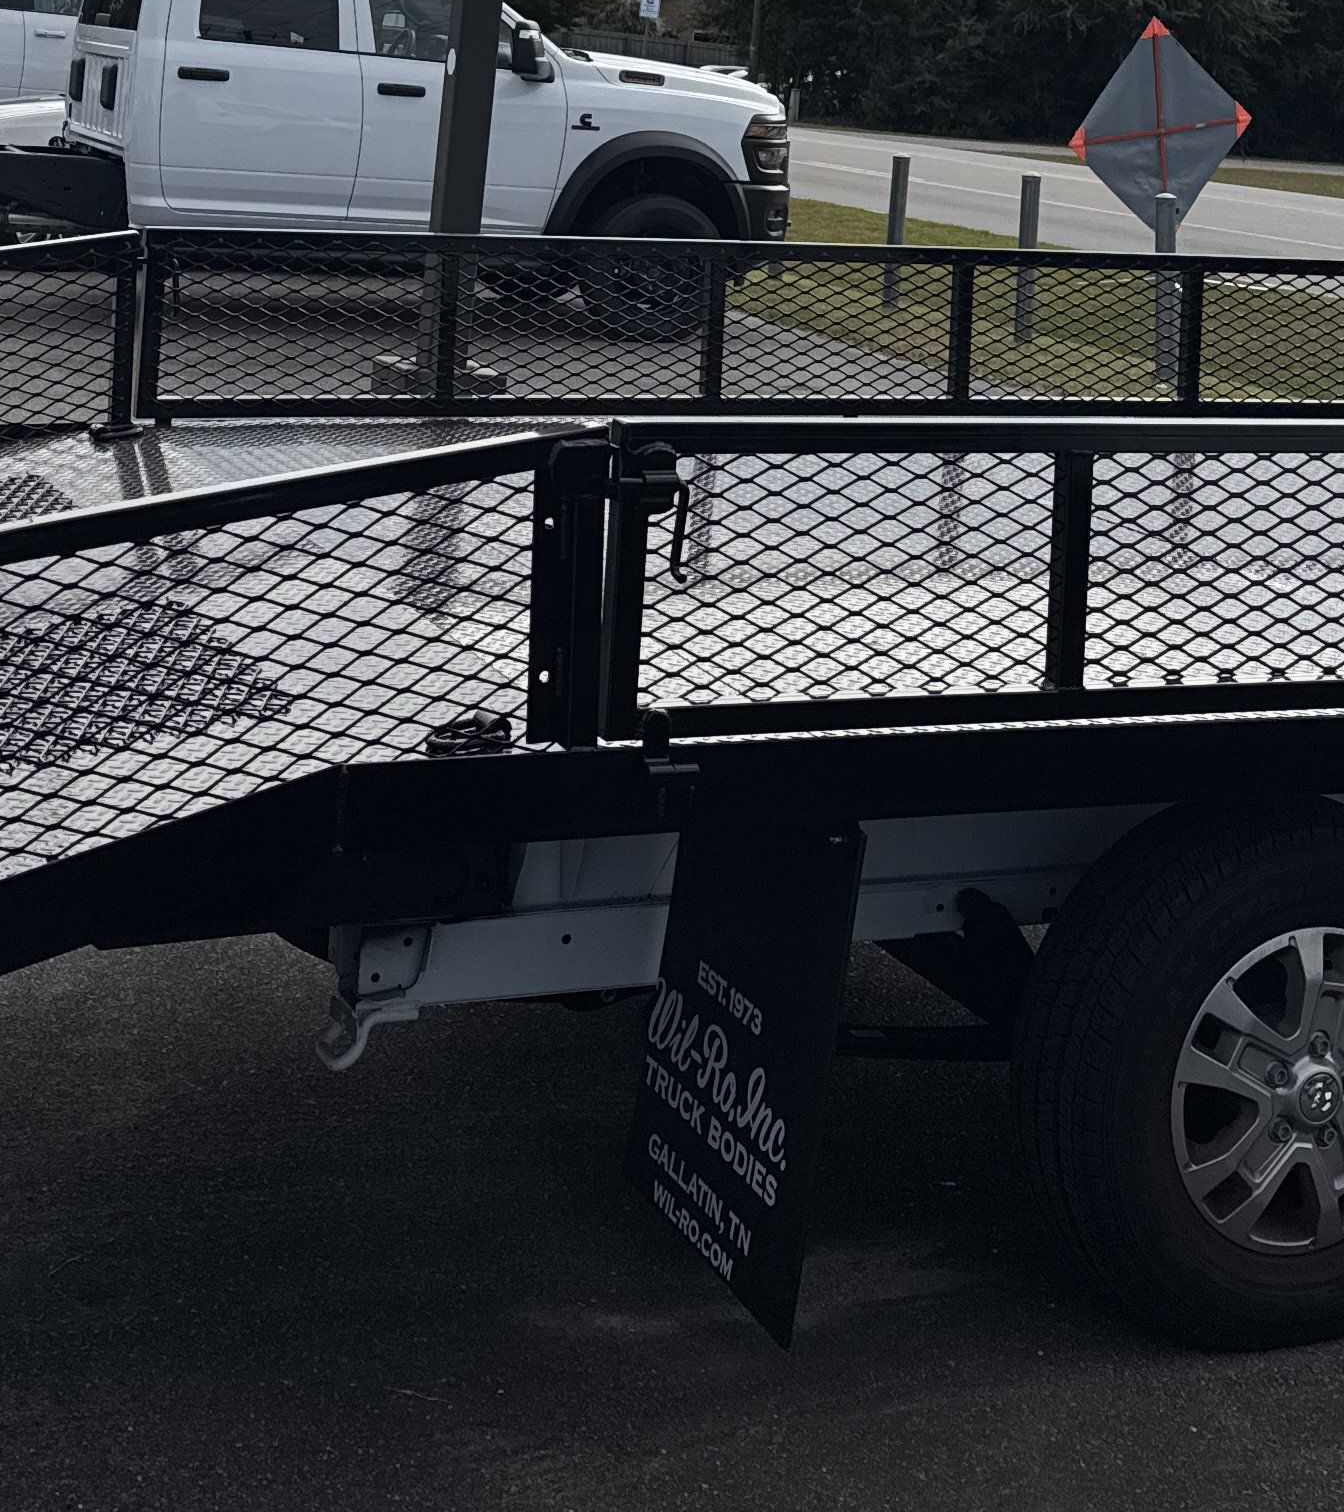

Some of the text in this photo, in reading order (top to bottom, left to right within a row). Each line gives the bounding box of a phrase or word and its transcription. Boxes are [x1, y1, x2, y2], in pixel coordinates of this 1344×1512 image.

[698, 959, 762, 1036] EST. 1973
[645, 1054, 778, 1207] TRUCK BODIES
[648, 977, 786, 1171] Wil-Ro, Inc.
[648, 1133, 752, 1257] GALLATIN, TN
[653, 1179, 734, 1281] WIL-RO.COM
